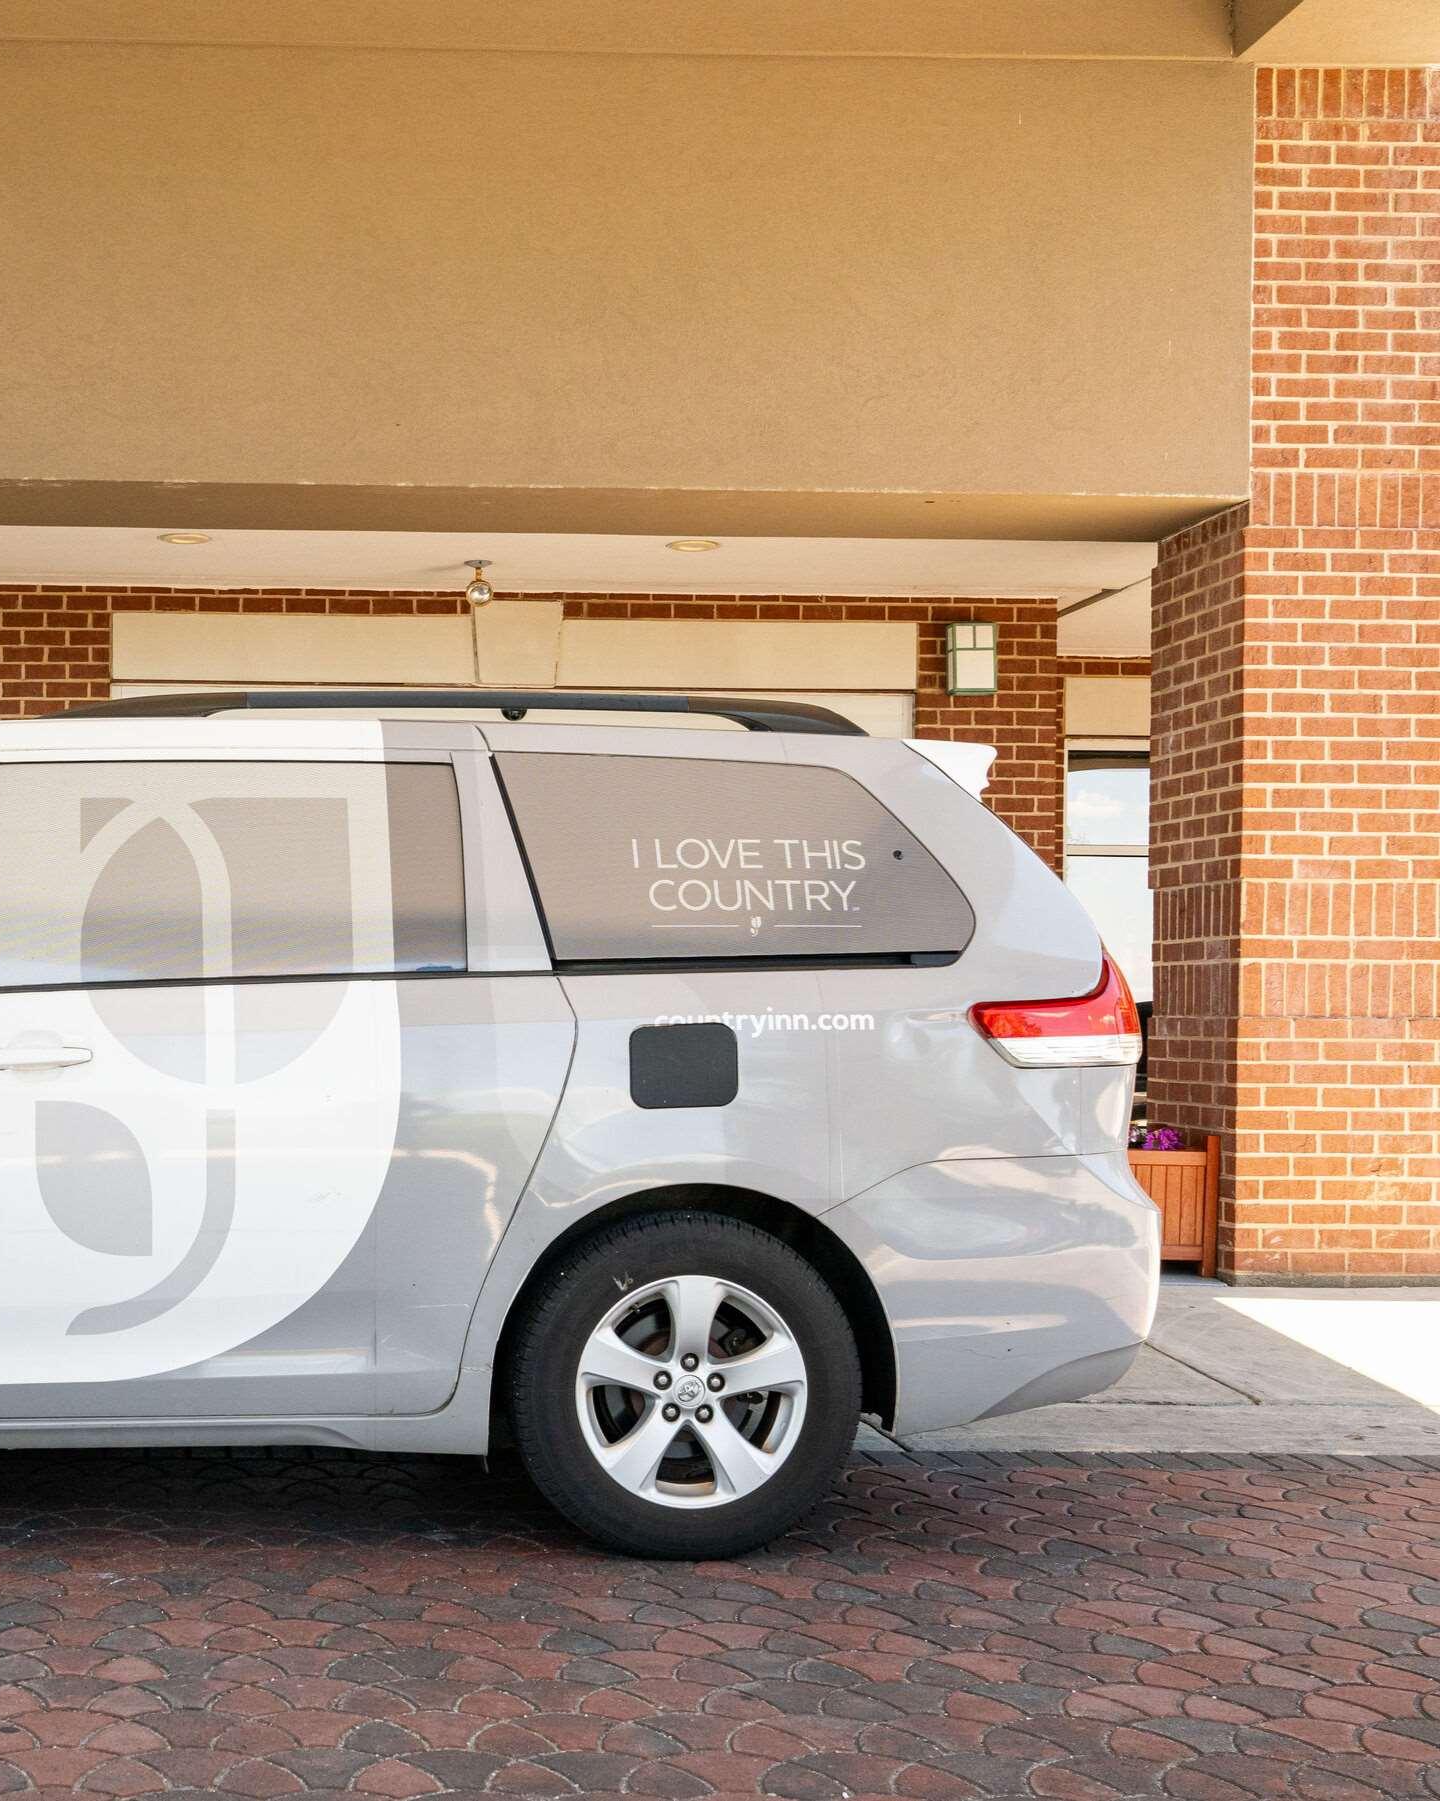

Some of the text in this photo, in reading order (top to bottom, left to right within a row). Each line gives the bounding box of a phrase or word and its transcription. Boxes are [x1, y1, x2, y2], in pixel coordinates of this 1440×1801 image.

[631, 838, 866, 870] I LOVE THIS
[648, 879, 858, 912] COUNTRY
